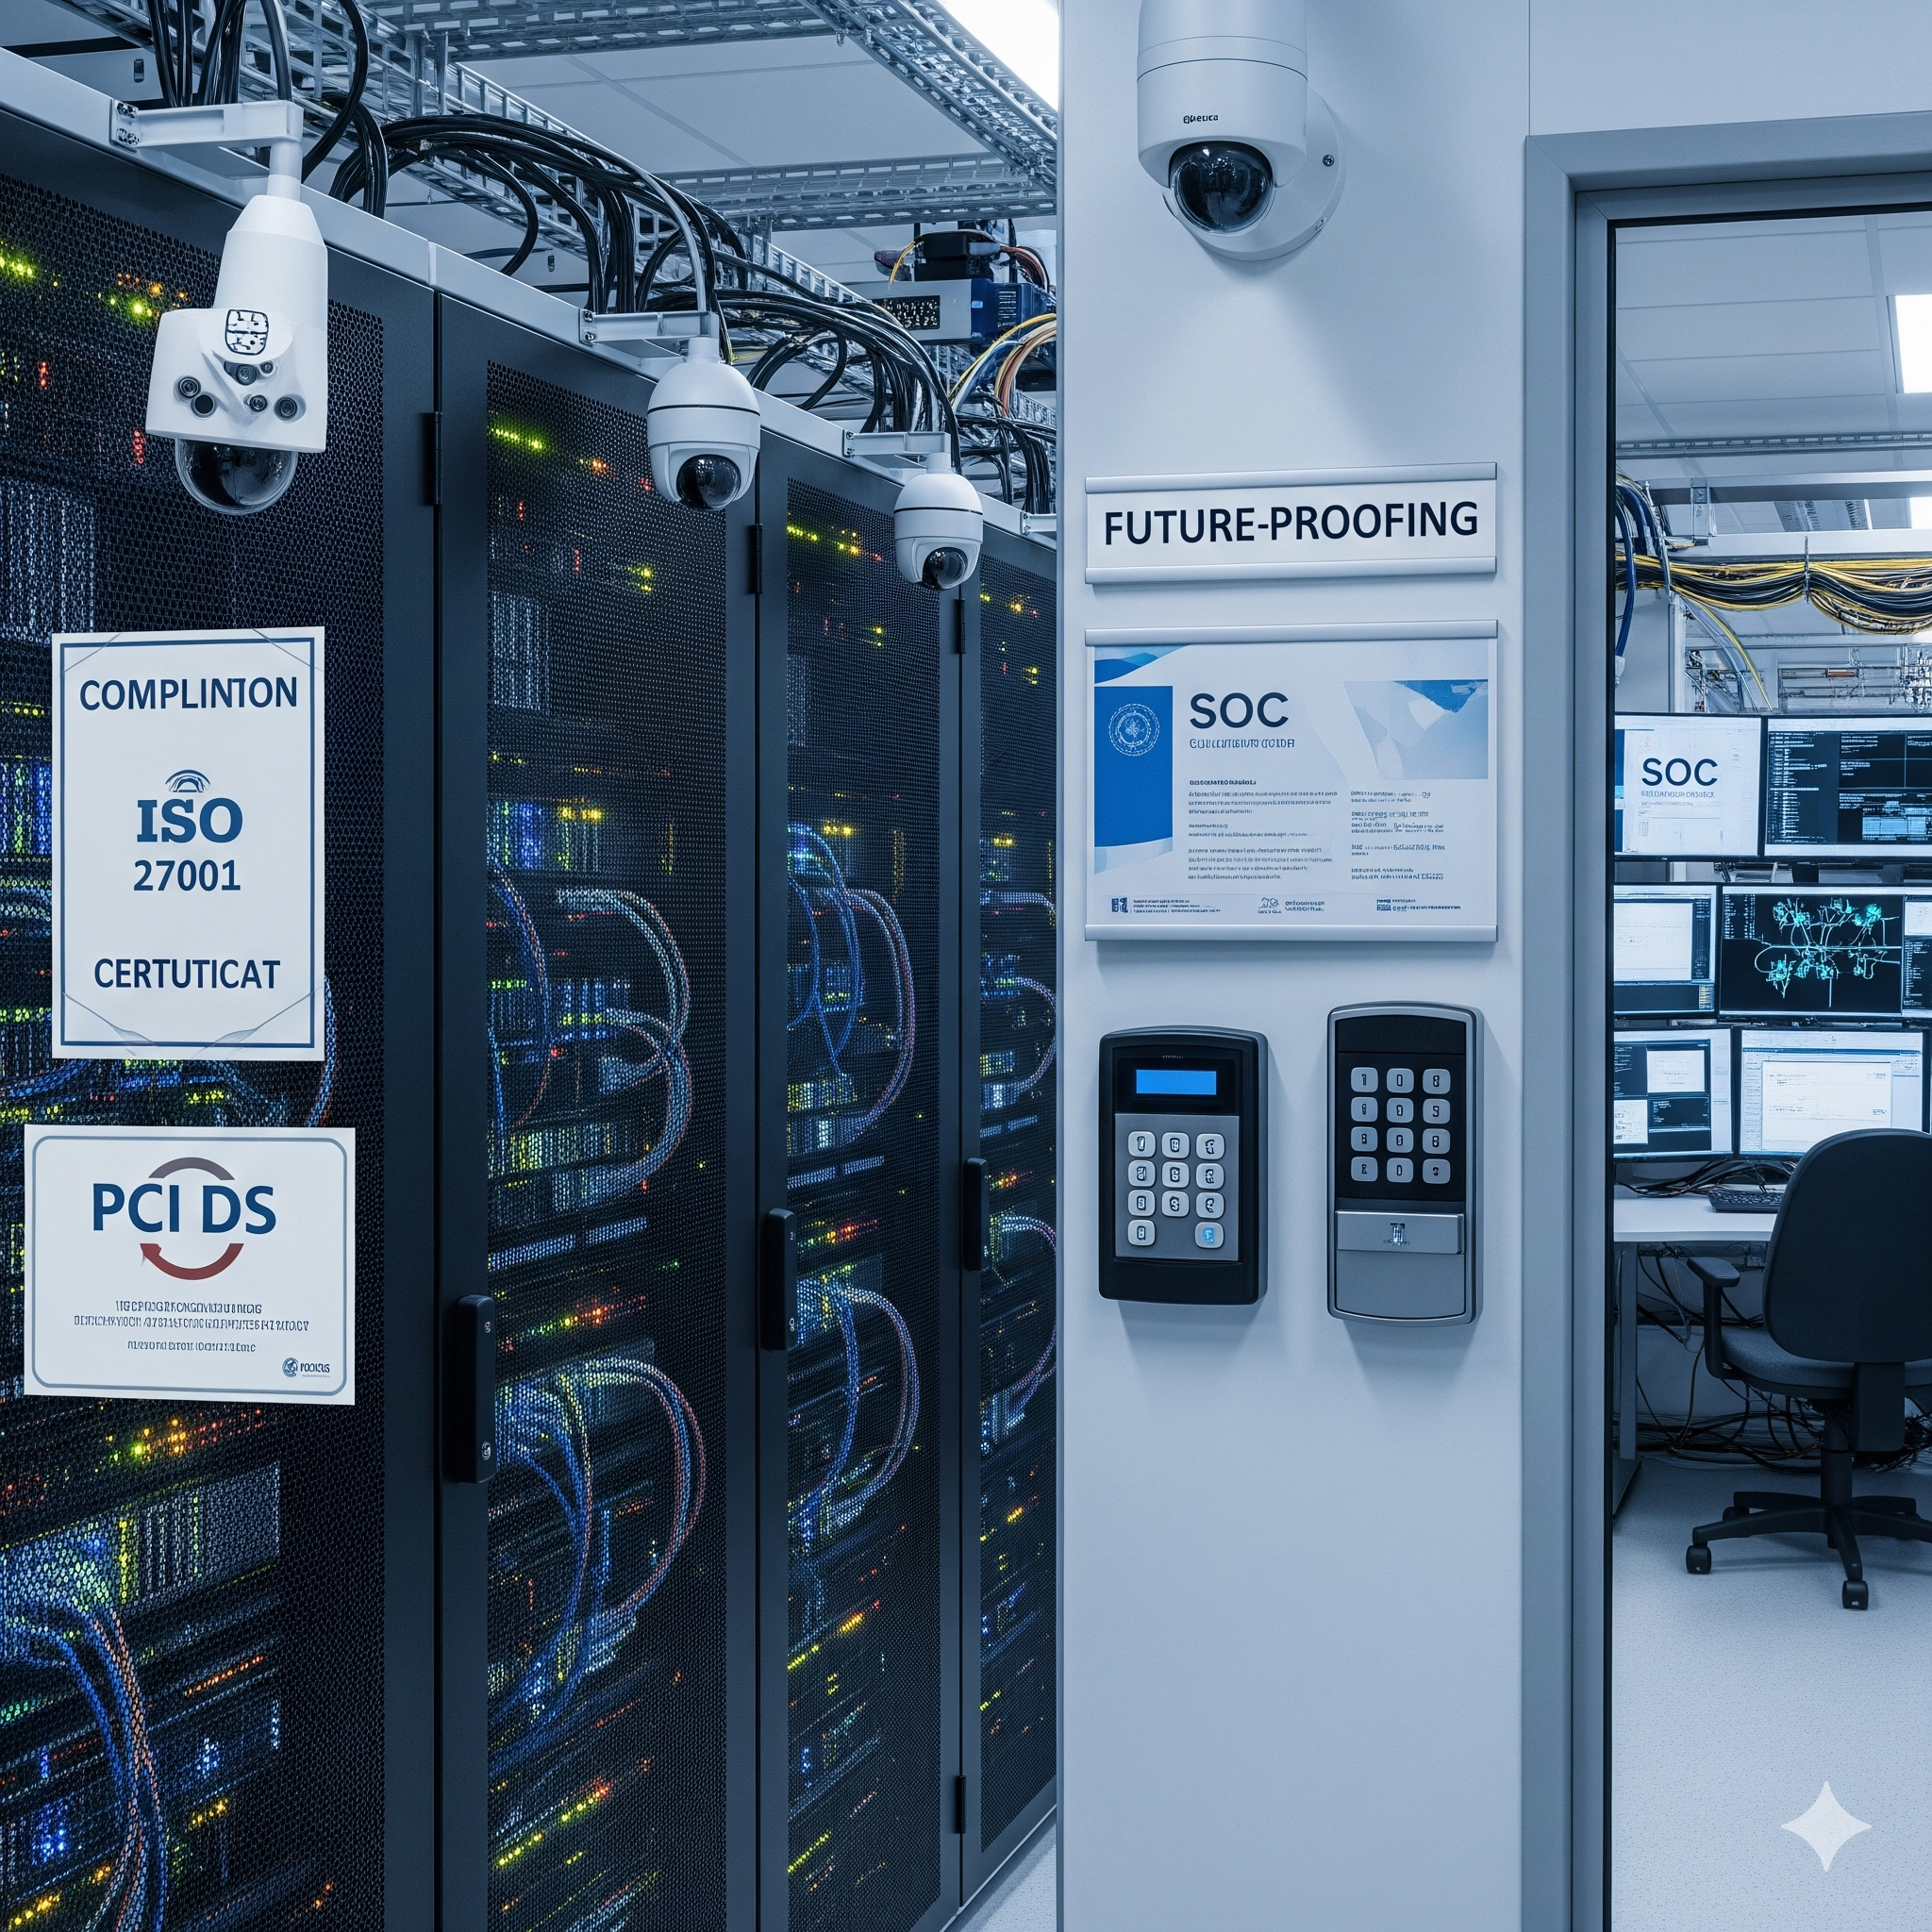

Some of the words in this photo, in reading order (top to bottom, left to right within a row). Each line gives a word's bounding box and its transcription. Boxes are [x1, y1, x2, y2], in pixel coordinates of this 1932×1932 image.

[1105, 501, 1478, 546] FUTURE-PROOFING
[1190, 691, 1290, 729] SOC
[1641, 758, 1719, 787] SOC
[136, 797, 243, 844] ISO
[133, 858, 242, 892] 27001
[94, 958, 281, 990] CERTUTICAT
[92, 1182, 180, 1233] PCI
[202, 1184, 276, 1235] DS
